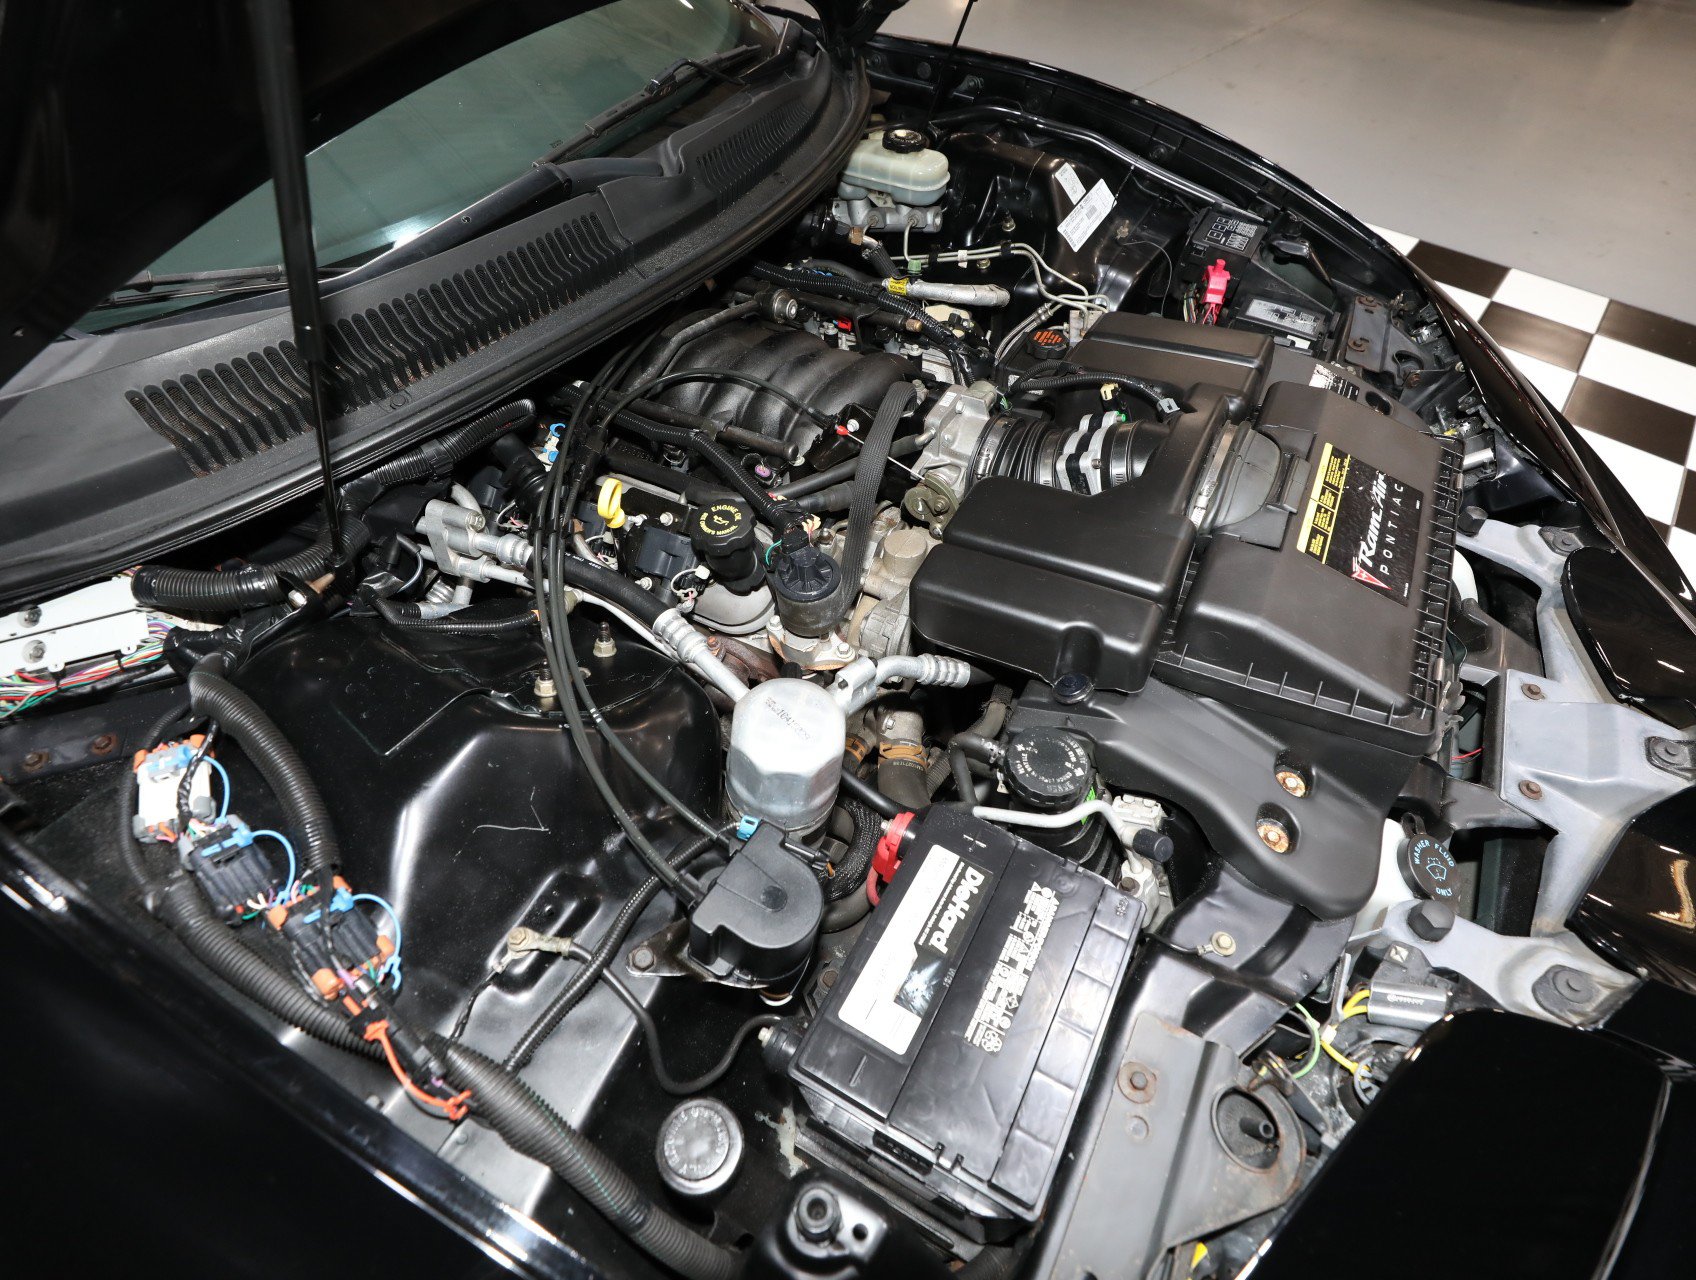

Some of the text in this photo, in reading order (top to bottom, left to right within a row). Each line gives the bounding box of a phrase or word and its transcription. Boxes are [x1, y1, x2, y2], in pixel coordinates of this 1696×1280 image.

[711, 505, 742, 521] ENGINE OIL
[1358, 473, 1388, 567] Ram Air
[1379, 483, 1404, 575] PONTIAC
[1414, 840, 1455, 867] WASHER FLUID
[928, 866, 985, 954] DieHard
[1435, 887, 1453, 896] ONLY
